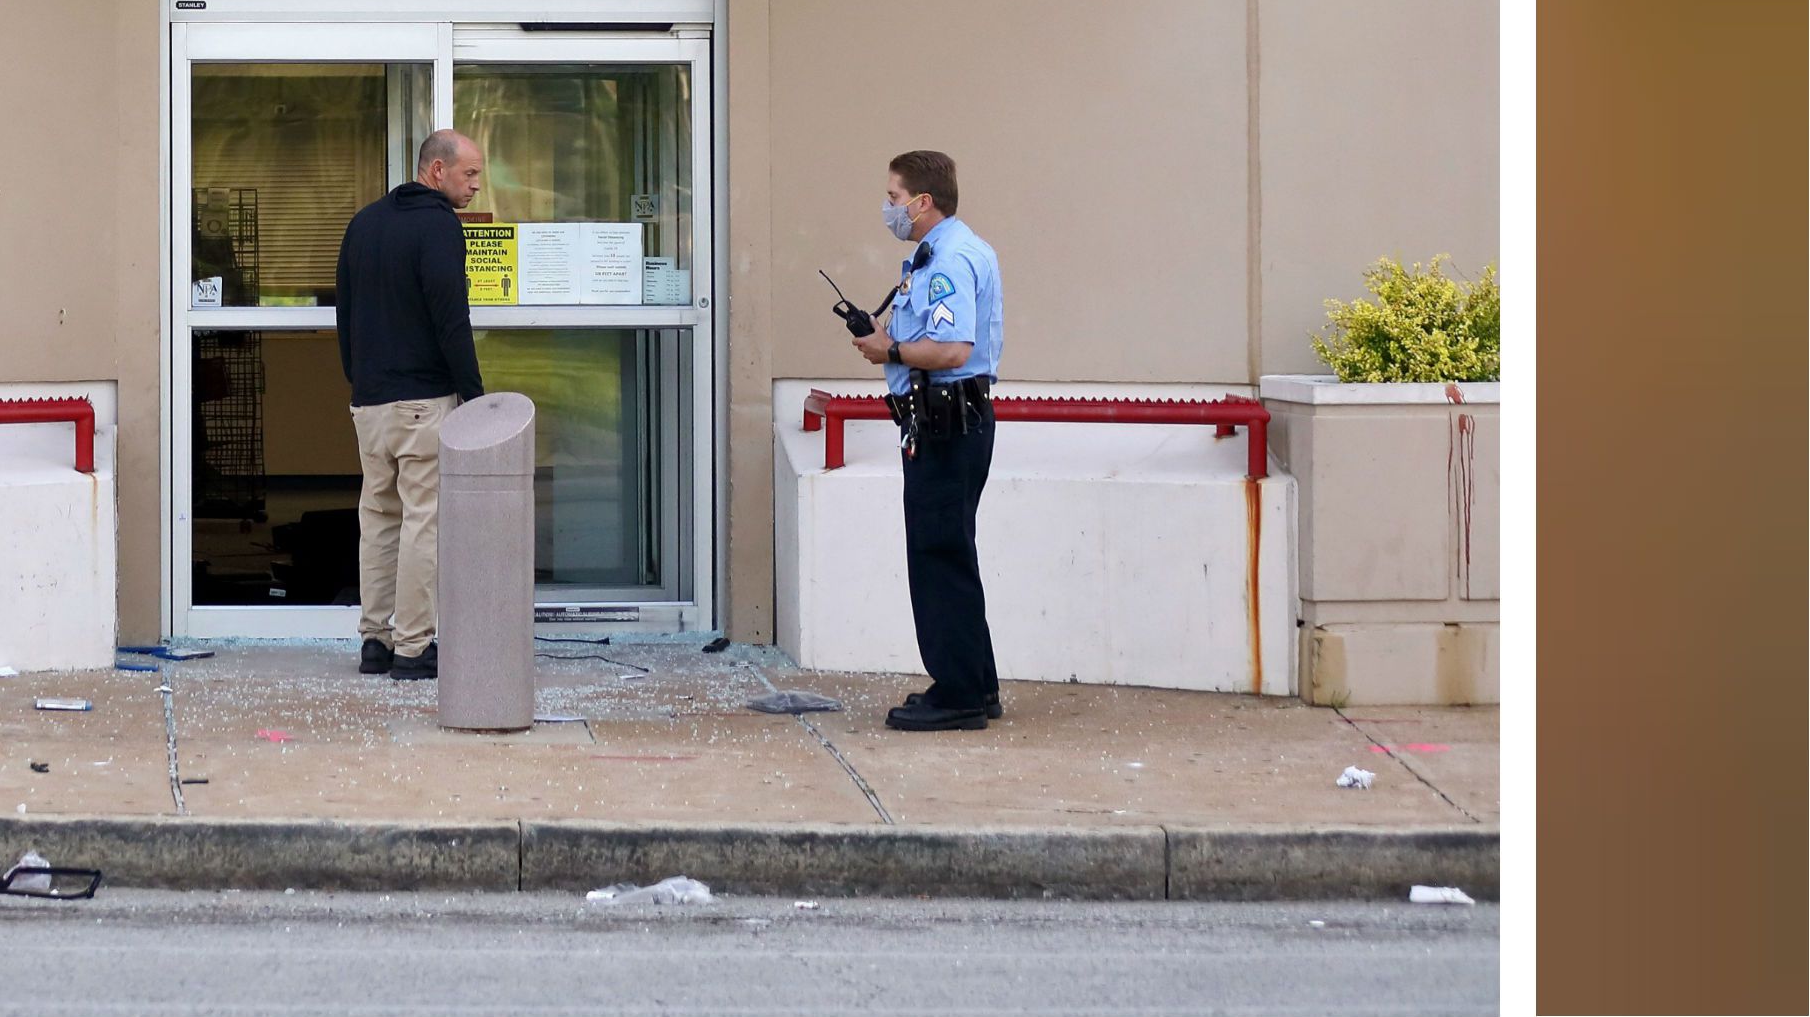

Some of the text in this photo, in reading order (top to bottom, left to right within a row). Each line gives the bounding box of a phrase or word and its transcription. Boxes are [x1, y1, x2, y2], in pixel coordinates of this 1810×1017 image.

[463, 229, 511, 237] ATTENTION
[470, 240, 503, 248] PLEASE
[196, 283, 218, 294] NPA
